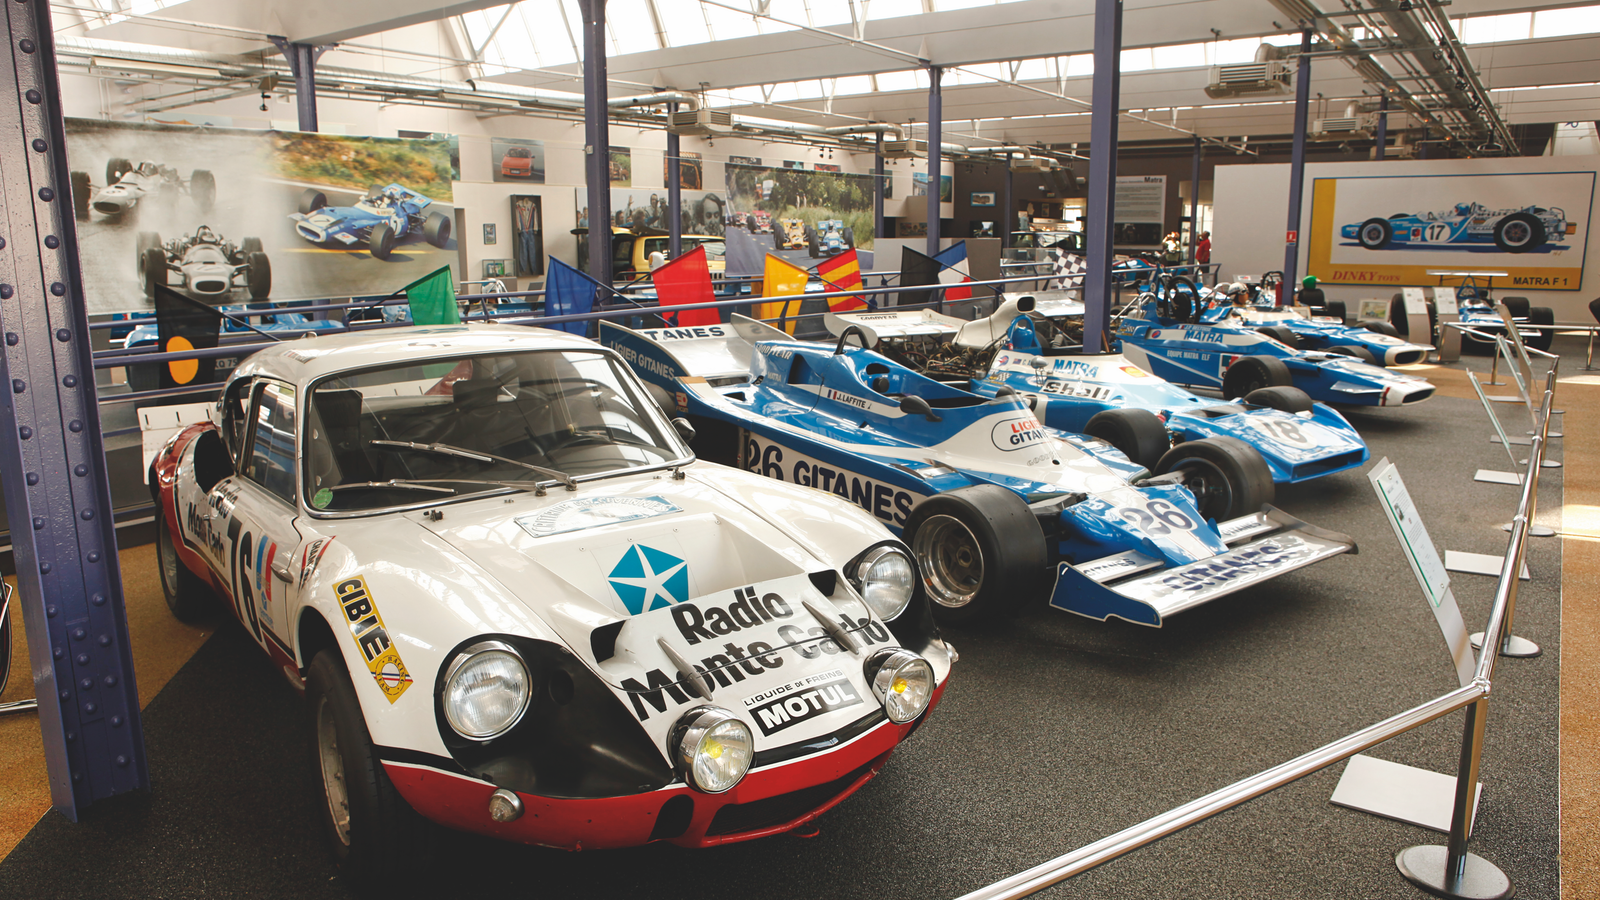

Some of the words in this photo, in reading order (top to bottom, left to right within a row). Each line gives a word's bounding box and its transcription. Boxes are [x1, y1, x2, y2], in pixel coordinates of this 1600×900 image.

[1428, 224, 1446, 241] 17
[1332, 270, 1377, 282] DINKY
[1377, 274, 1400, 282] TOYS
[1513, 277, 1550, 286] MATRA
[1553, 277, 1560, 286] F
[1563, 277, 1568, 286] 1
[638, 326, 725, 341] TANES
[1184, 330, 1223, 343] MATRA
[611, 340, 637, 367] LIGIER
[638, 356, 675, 382] GITANES
[1167, 350, 1182, 359] EQUIPE
[1183, 351, 1199, 360] MATRA
[1202, 353, 1211, 361] ELF
[1052, 358, 1099, 378] MATRA
[1042, 381, 1111, 400] Shell
[1010, 419, 1041, 433] LIGIE
[1255, 418, 1308, 444] 18
[749, 438, 784, 481] 26
[793, 460, 913, 527] GITANES
[1120, 499, 1193, 536] 26
[670, 586, 794, 646] Radio
[620, 641, 784, 722] Monte
[777, 612, 891, 661] Carlo
[744, 683, 793, 707] LIQUIDE
[794, 680, 804, 688] DE
[805, 669, 843, 685] FREINS
[757, 682, 856, 730] MOTUL
